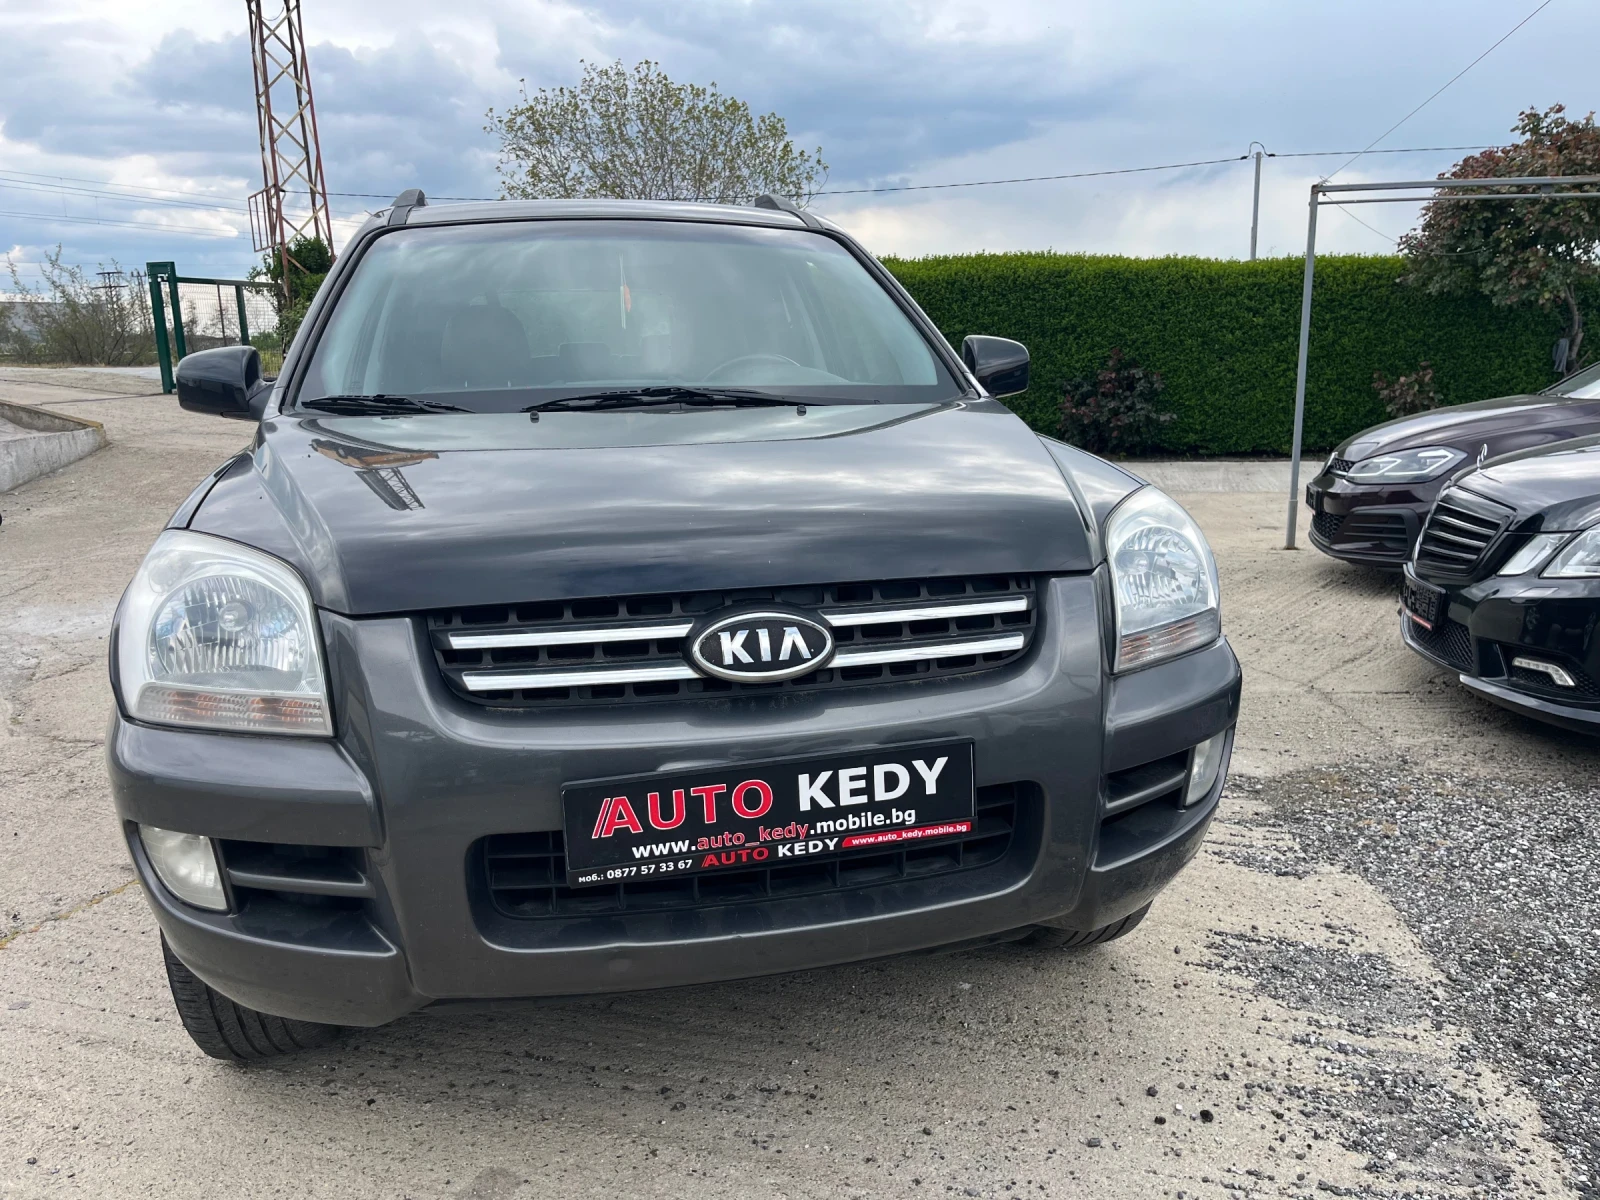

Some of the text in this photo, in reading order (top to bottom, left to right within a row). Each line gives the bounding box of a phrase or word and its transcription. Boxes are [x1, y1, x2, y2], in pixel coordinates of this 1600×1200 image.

[718, 626, 812, 666] KIA
[592, 756, 949, 839] AUTO KEDY
[631, 808, 916, 859] www.auto_kedy.mobile.bg
[851, 824, 967, 845] www.auto_kedy.mobile.bg
[606, 867, 637, 880] 0877
[641, 864, 656, 875] 57
[659, 862, 675, 872] 33
[678, 859, 693, 869] 67
[701, 837, 839, 868] AUTO KEDY
